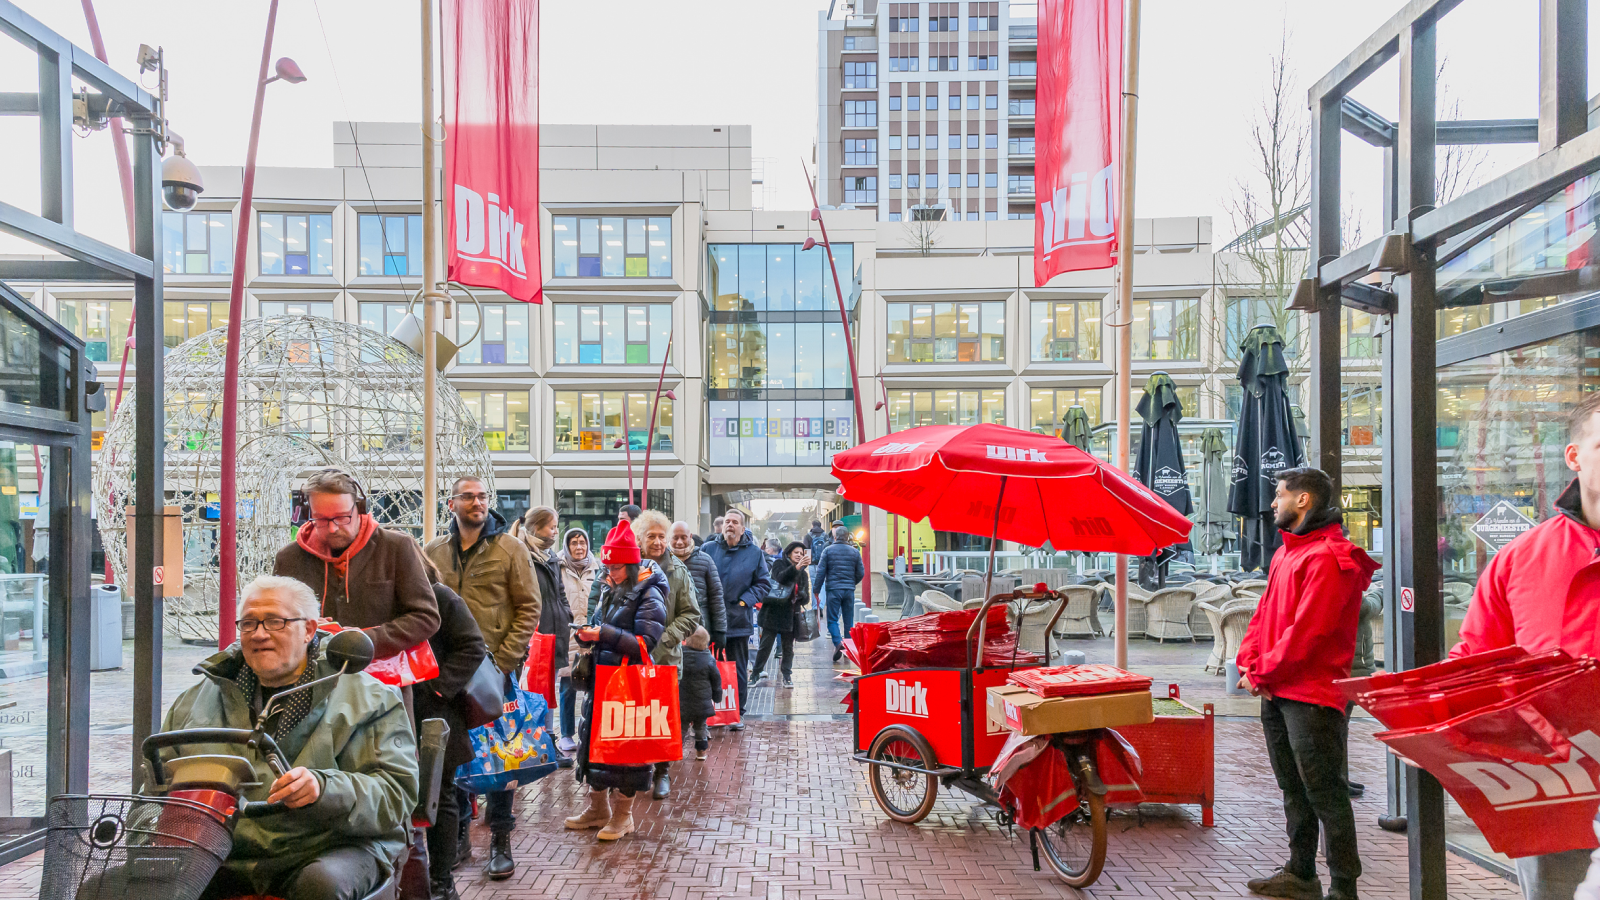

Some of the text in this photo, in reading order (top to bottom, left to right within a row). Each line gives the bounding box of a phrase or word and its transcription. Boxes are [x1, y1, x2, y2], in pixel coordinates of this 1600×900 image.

[455, 184, 527, 275] Dirk
[986, 445, 1049, 462] Dirk
[1476, 524, 1530, 532] BURGEMEESTER
[886, 678, 929, 716] Dirk
[601, 699, 672, 738] Dirk
